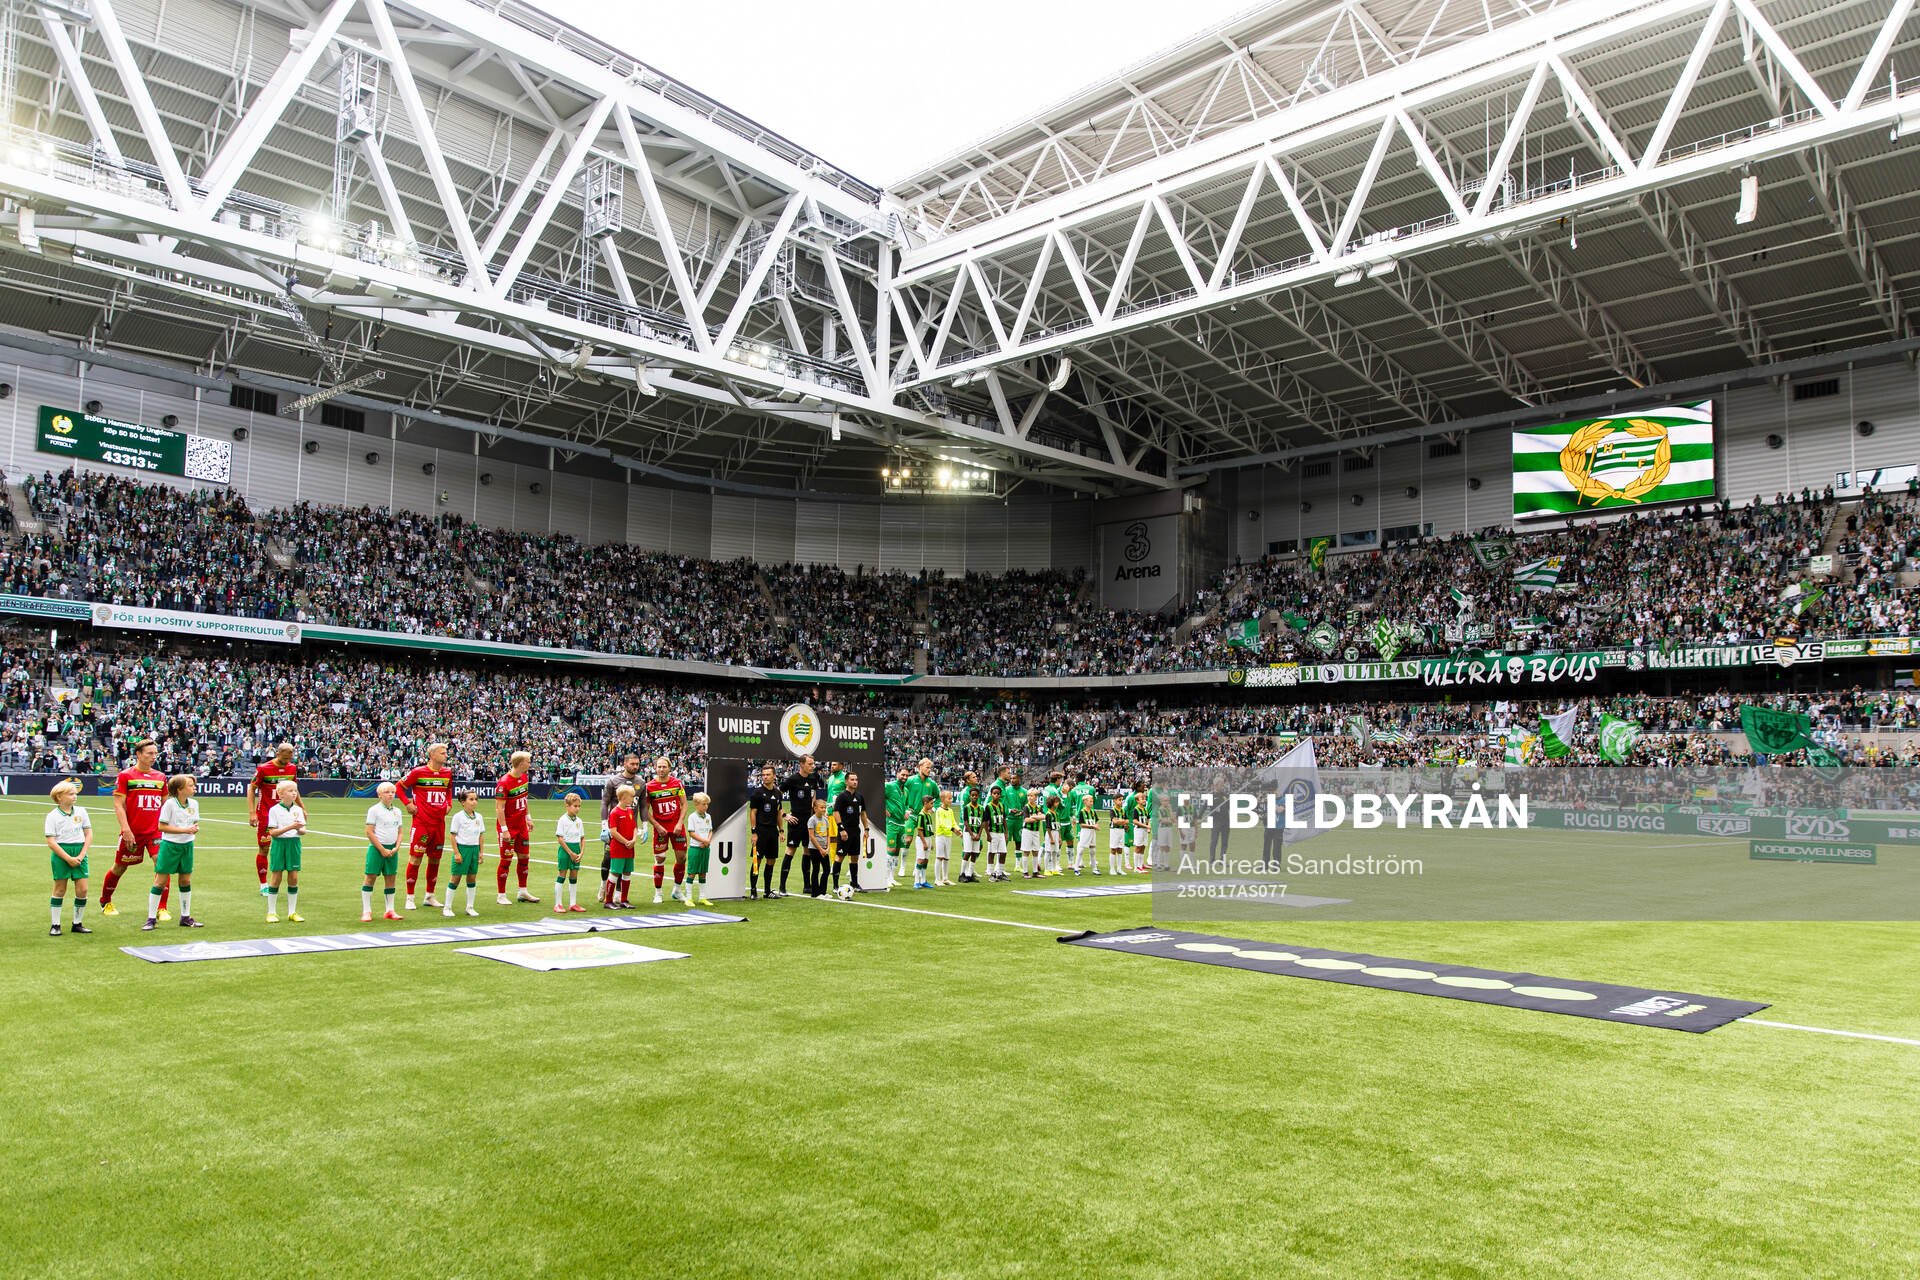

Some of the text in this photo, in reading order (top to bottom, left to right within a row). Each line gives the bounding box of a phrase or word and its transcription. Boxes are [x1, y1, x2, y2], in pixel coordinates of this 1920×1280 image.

[84, 414, 106, 425] Stötta
[108, 419, 145, 432] Hammarby
[146, 425, 174, 438] Ungdom
[104, 427, 117, 436] Köp
[99, 441, 138, 454] Vinstsumma
[139, 448, 151, 456] just
[103, 451, 158, 470] 43313 kr
[1124, 522, 1151, 562] 3
[1114, 564, 1161, 581] Arena
[113, 612, 284, 637] FÖR EN POSITIV SUPPORTERKULTUR
[1649, 645, 1750, 669] KOLLEKTIVET
[1343, 662, 1418, 680] ULTRAS
[1423, 655, 1504, 686] ULTRA
[1528, 655, 1600, 683] BOYS
[718, 717, 770, 735] UNIBET
[829, 725, 876, 741] UNIBET
[195, 783, 224, 794] TUR.
[228, 781, 244, 794] PÅ
[137, 795, 162, 808] ITS
[426, 791, 447, 803] ITS
[657, 800, 678, 814] ITS
[1563, 812, 1666, 830] RUGU BYGG
[1700, 818, 1749, 834] EXAB
[1785, 818, 1850, 836] RYDS
[718, 841, 732, 864] U
